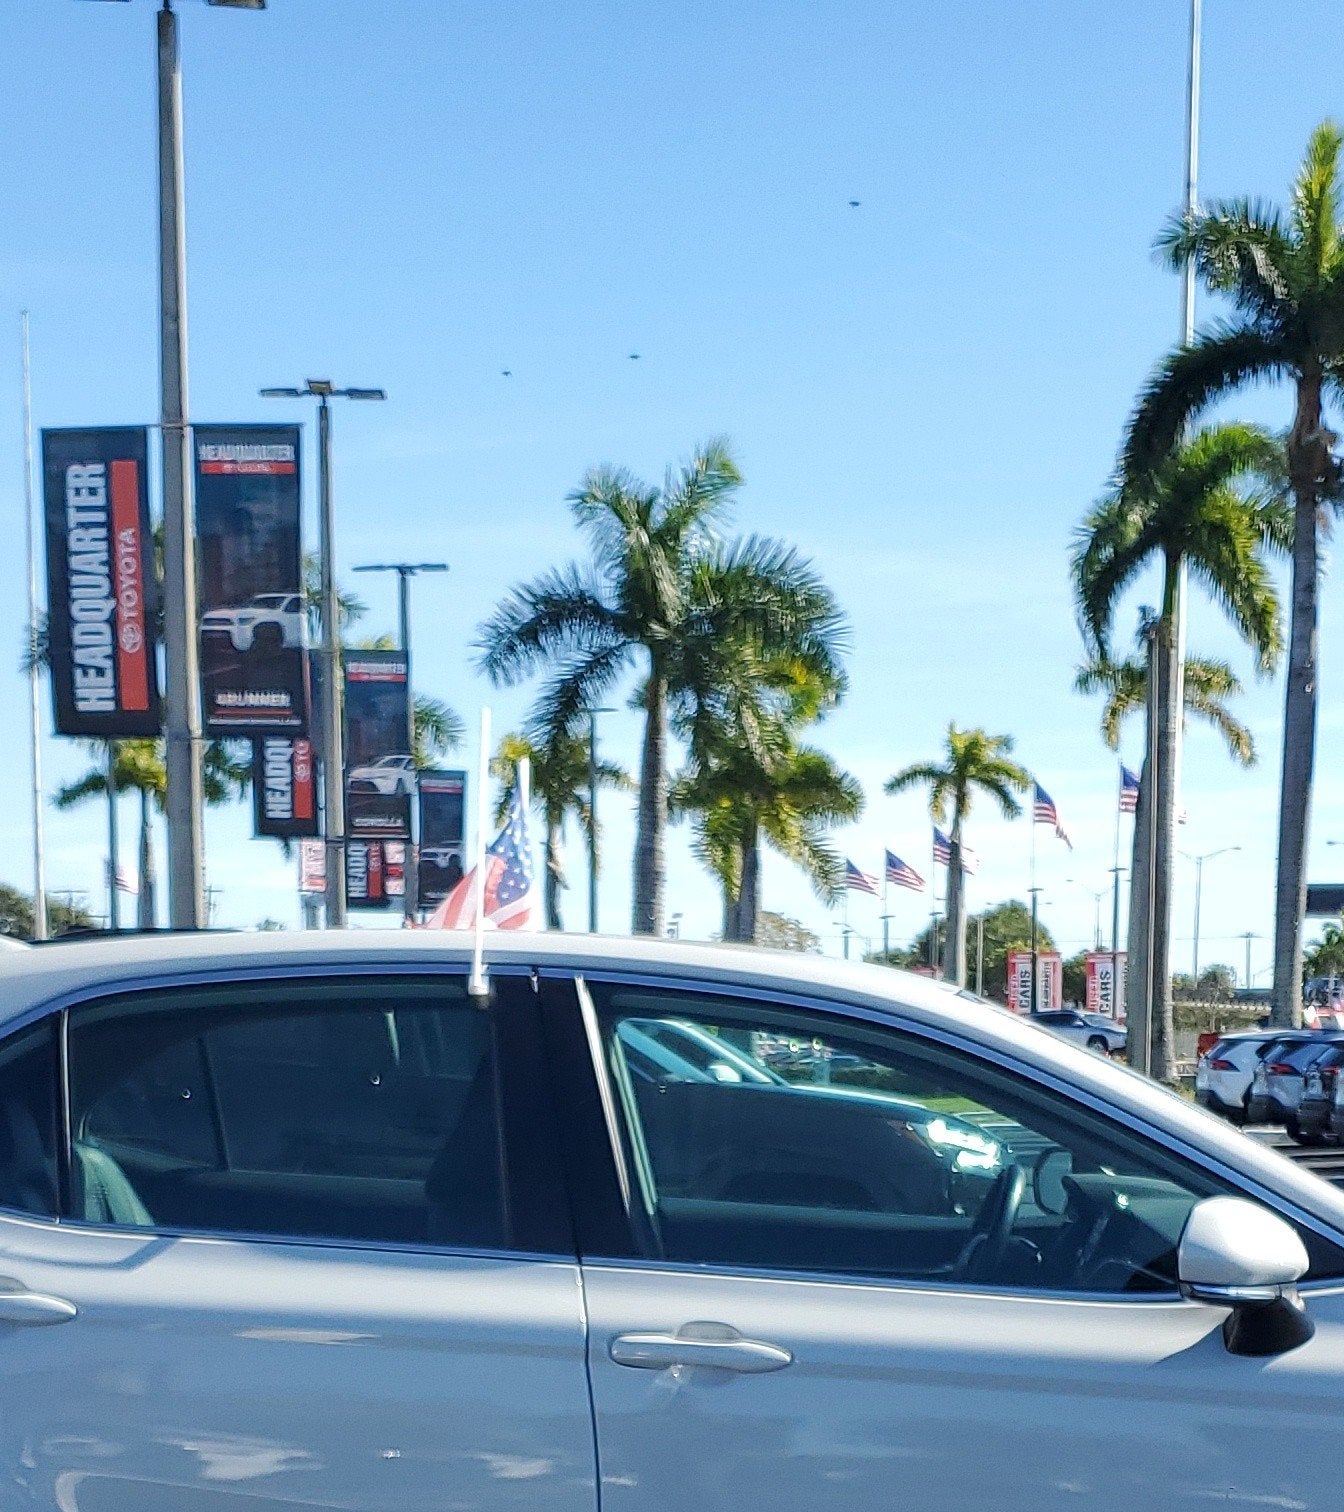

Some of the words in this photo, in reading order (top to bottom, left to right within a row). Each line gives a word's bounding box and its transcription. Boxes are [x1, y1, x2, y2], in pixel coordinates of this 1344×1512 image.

[66, 462, 117, 712] HEADQUARTER
[118, 527, 139, 619] TOYOTA
[1099, 971, 1112, 1013] CARS
